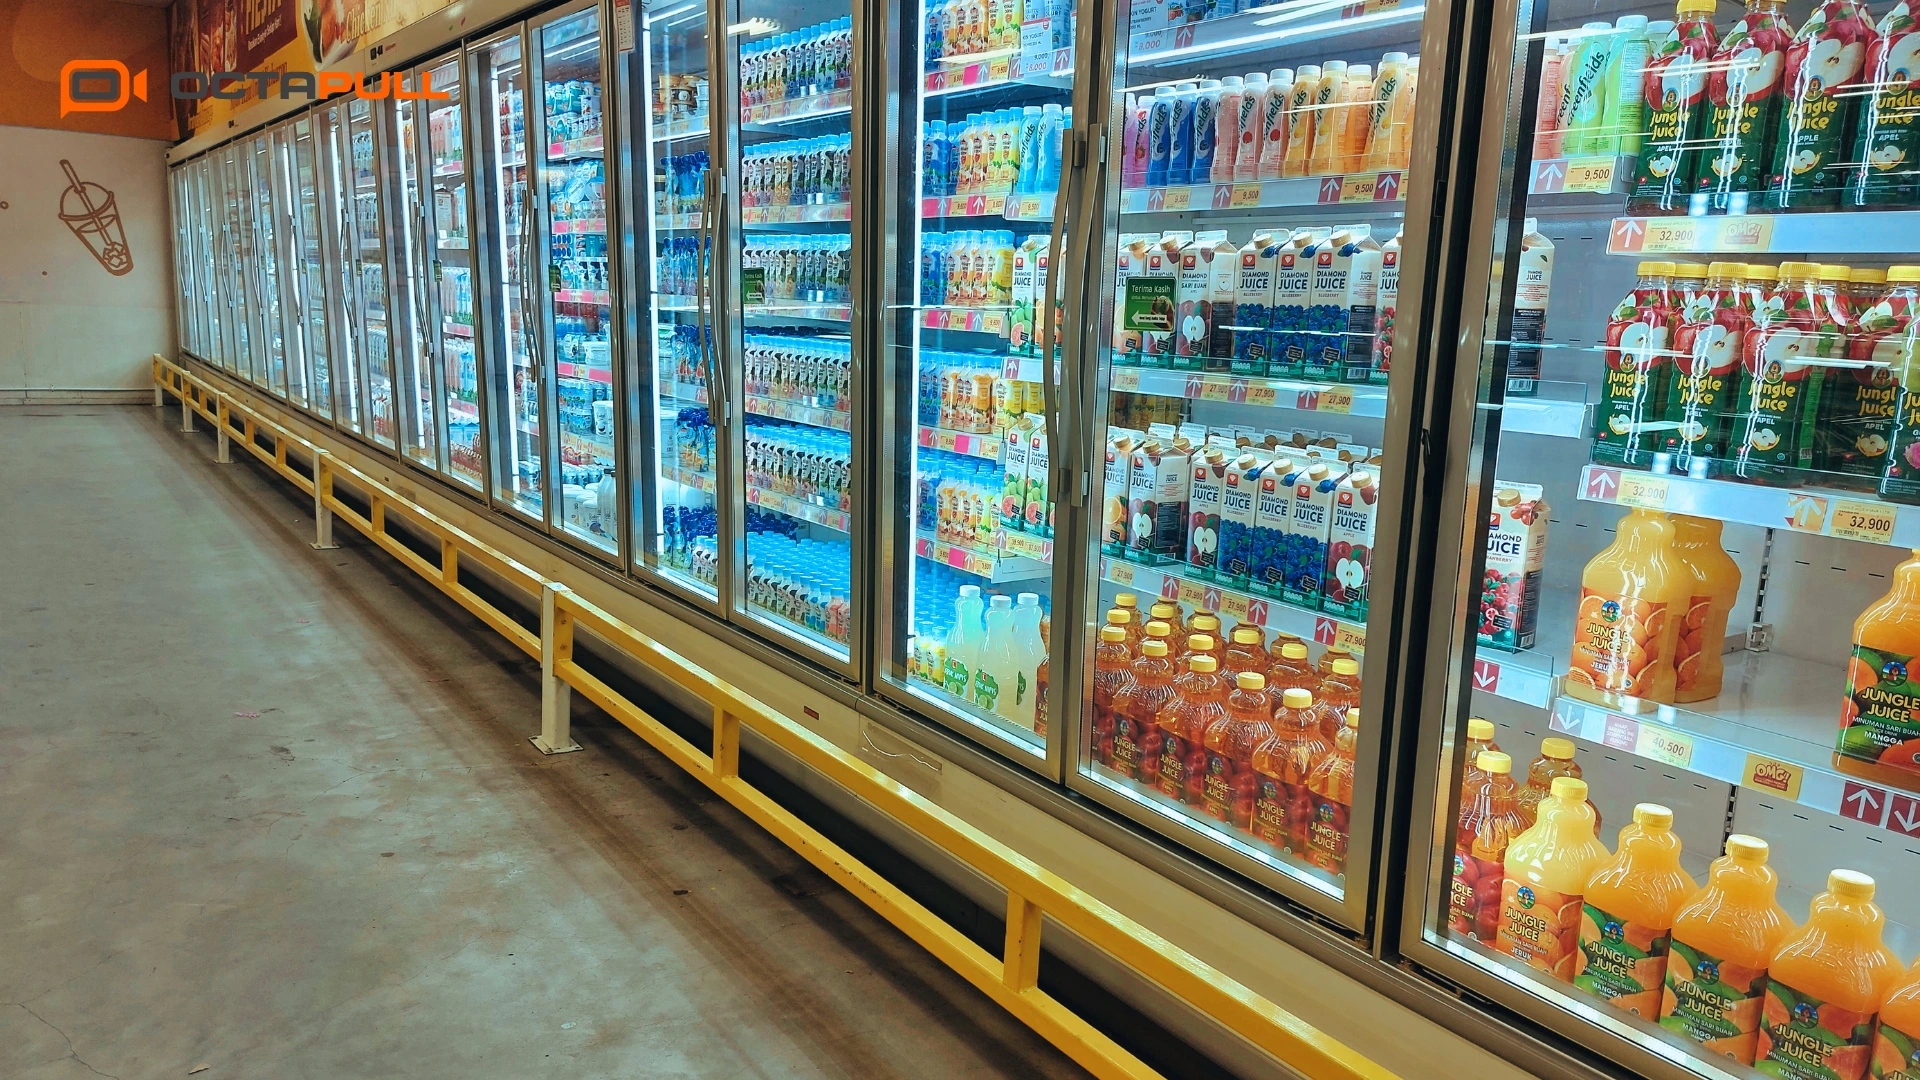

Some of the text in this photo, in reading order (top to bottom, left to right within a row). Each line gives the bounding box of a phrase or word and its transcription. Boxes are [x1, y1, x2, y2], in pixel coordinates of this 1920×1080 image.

[1874, 90, 1920, 110] ungle
[1650, 108, 1690, 127] Jungle
[1712, 105, 1759, 124] Jungle
[1652, 125, 1684, 141] Juice
[1714, 121, 1751, 138] Juice
[1584, 168, 1610, 181] 9,500
[1355, 183, 1374, 194] 9,500
[1660, 230, 1693, 242] 32,900
[1013, 277, 1031, 287] JUICE
[1131, 284, 1171, 293] Terima Kasih
[1240, 278, 1268, 289] JUICE
[1278, 279, 1308, 290] JUICE
[1314, 278, 1346, 290] JUICE
[1608, 370, 1645, 385] Jungle
[1678, 374, 1722, 391] Jungle
[1610, 383, 1637, 398] Juice
[1680, 388, 1714, 405] Juice
[1856, 385, 1897, 402] Jungl
[1328, 394, 1351, 405] 27,900
[1865, 423, 1885, 431] APEL
[1007, 452, 1025, 464] JUICE
[1030, 457, 1048, 469] JUICE
[1131, 476, 1154, 489] JUICE
[1193, 482, 1219, 492] DIAMOND
[1192, 490, 1219, 502] JUICE
[1225, 488, 1252, 499] DIAMOND
[1261, 494, 1288, 505] DIAMOND
[1632, 485, 1665, 500] 32,900
[1224, 498, 1251, 510] JUICE
[1259, 503, 1288, 516] JUICE
[1296, 501, 1325, 513] DIAMOND
[1293, 508, 1323, 523] JUICE
[1337, 508, 1368, 520] DIAMOND
[1296, 523, 1317, 531] BLUEBERRY
[1335, 516, 1367, 532] JUICE
[1850, 515, 1890, 532] 32,900
[1587, 622, 1631, 643] JUNGLE
[1861, 687, 1920, 710] JUNGLE
[1867, 703, 1911, 723] JUICE
[1852, 716, 1885, 729] MINUMAN
[1886, 724, 1901, 732] SARI
[1114, 735, 1136, 751] JUNGLE
[1653, 736, 1685, 756] 40,500
[1864, 731, 1904, 746] MANGGA
[1115, 746, 1132, 760] JUICE
[1160, 753, 1183, 771] JUNGLE
[1161, 765, 1178, 779] JUICE
[1755, 763, 1791, 783] OMG!
[1204, 774, 1229, 793] JUNGLE
[1206, 785, 1225, 800] JUICE
[1256, 798, 1285, 817] JUNGLE
[1259, 810, 1281, 826] JUICE
[1310, 821, 1341, 842] JUNGLE
[1312, 833, 1336, 851] JUICE
[1505, 907, 1546, 932] JUNGLE
[1509, 921, 1539, 942] JUICE
[1511, 947, 1532, 960] JERUK
[1589, 941, 1636, 969] JUNGLE
[1594, 957, 1628, 979] JUICE
[1592, 981, 1622, 999] MANGGA
[1681, 980, 1732, 1011] JUNGLE
[1685, 997, 1723, 1021] JUICE
[1672, 1007, 1733, 1037] MINUMAN SARI BUAH
[1682, 1023, 1717, 1042] MANGGA
[1775, 1023, 1834, 1058] JUNGLE
[1766, 1049, 1798, 1070] MINUMAN
[1798, 1065, 1815, 1076] SARI
[1781, 1042, 1823, 1067] JUICE
